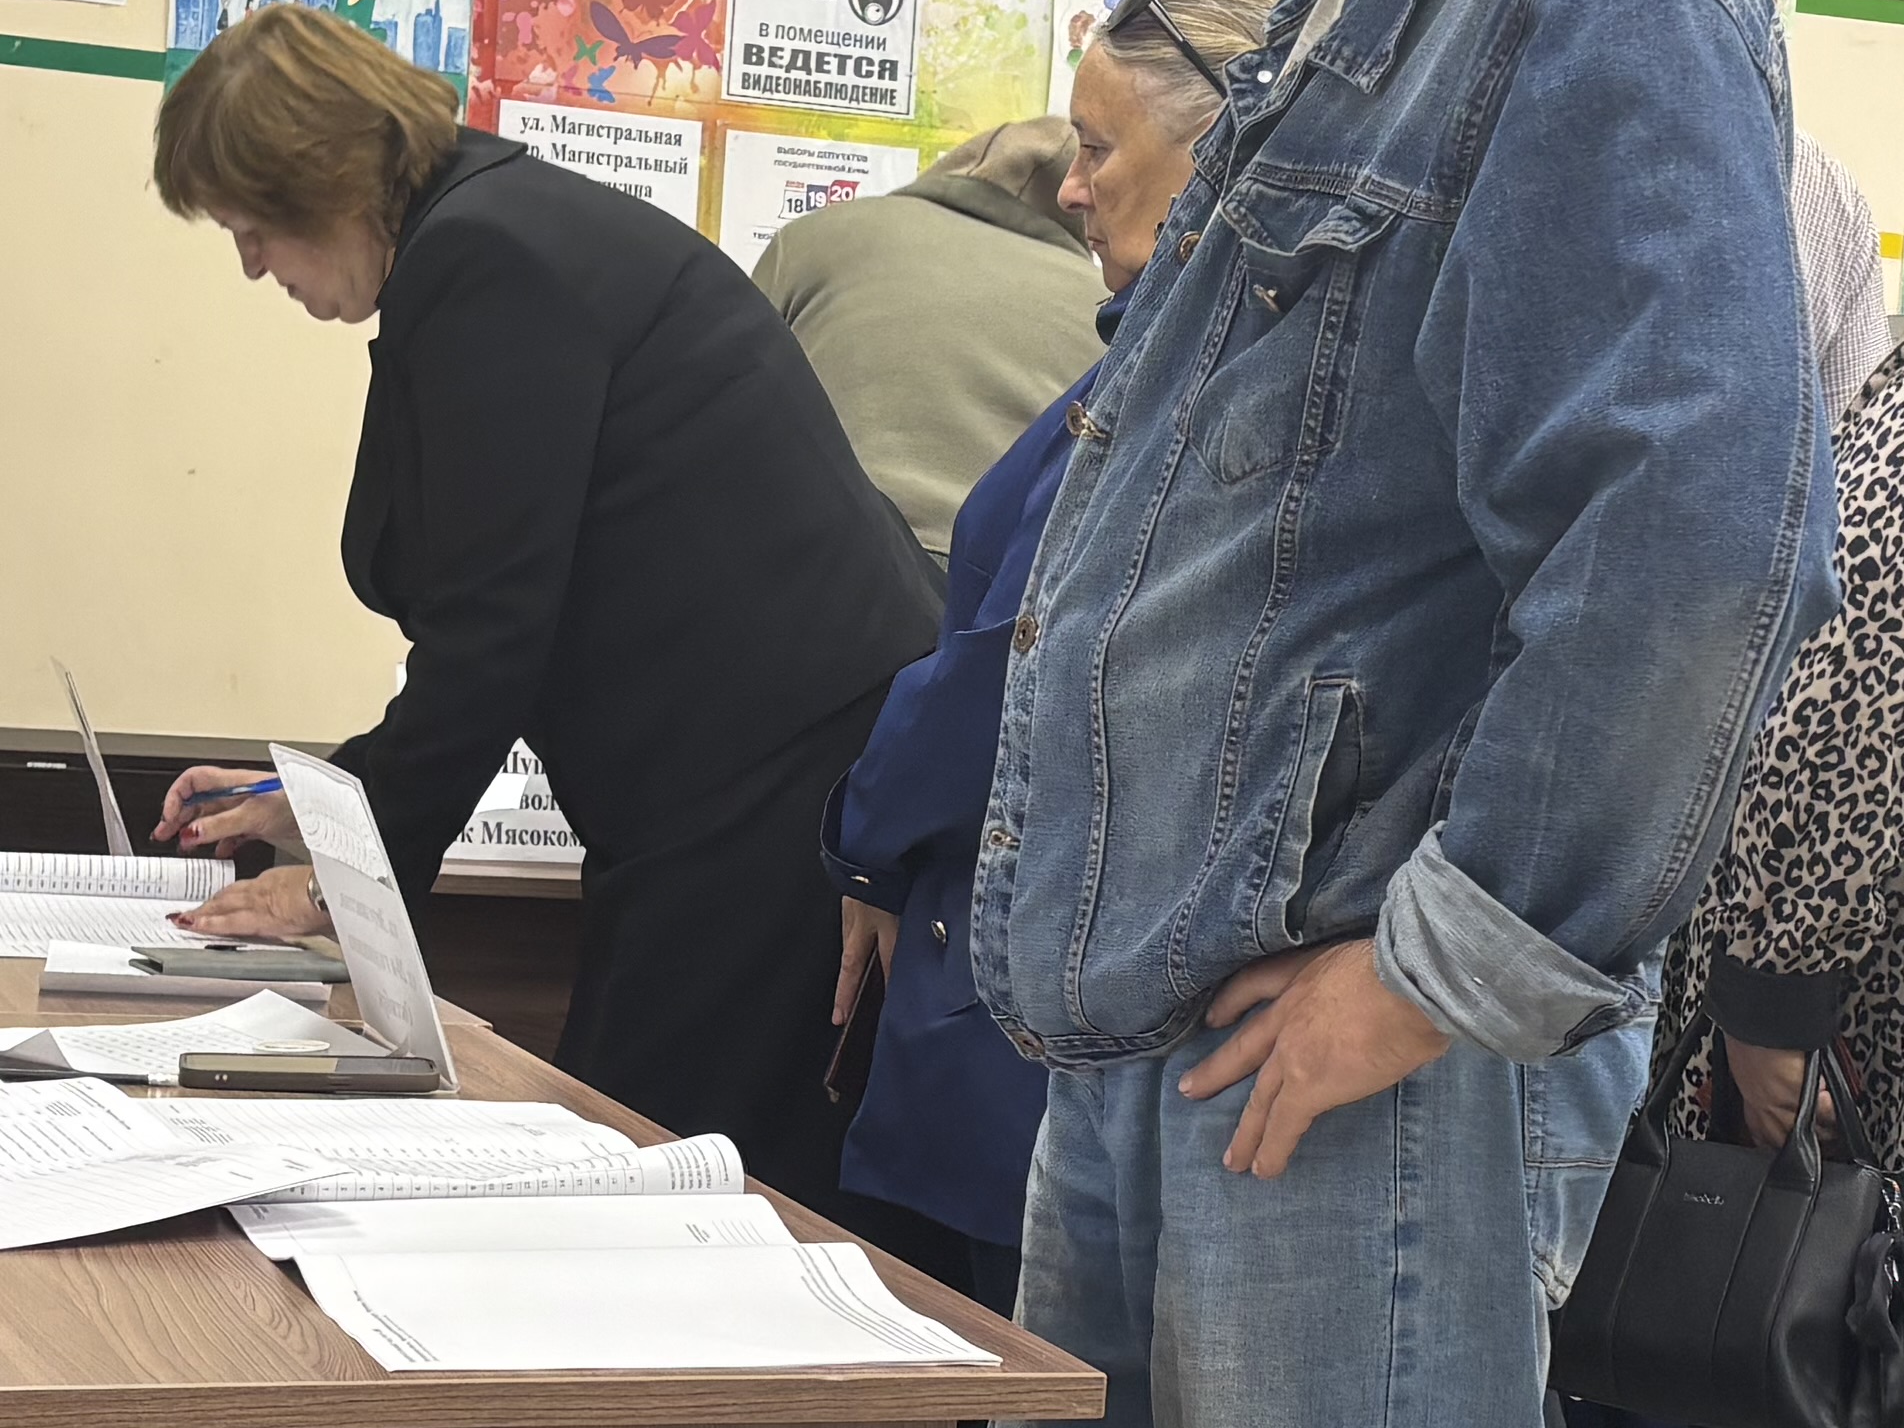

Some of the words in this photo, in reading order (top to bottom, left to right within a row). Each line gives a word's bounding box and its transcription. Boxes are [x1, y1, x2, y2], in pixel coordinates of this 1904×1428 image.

[758, 22, 770, 38] В
[774, 24, 887, 52] помещении
[743, 42, 899, 82] ВЕДЕТСЯ
[741, 72, 897, 107] ВИДЕОНАБЛЮДЕНИЕ
[520, 115, 545, 134] ул.
[550, 114, 683, 147] Магистральная
[550, 142, 689, 176] Магистральный
[786, 198, 804, 213] 18
[809, 191, 827, 209] 19
[830, 185, 854, 202] 20
